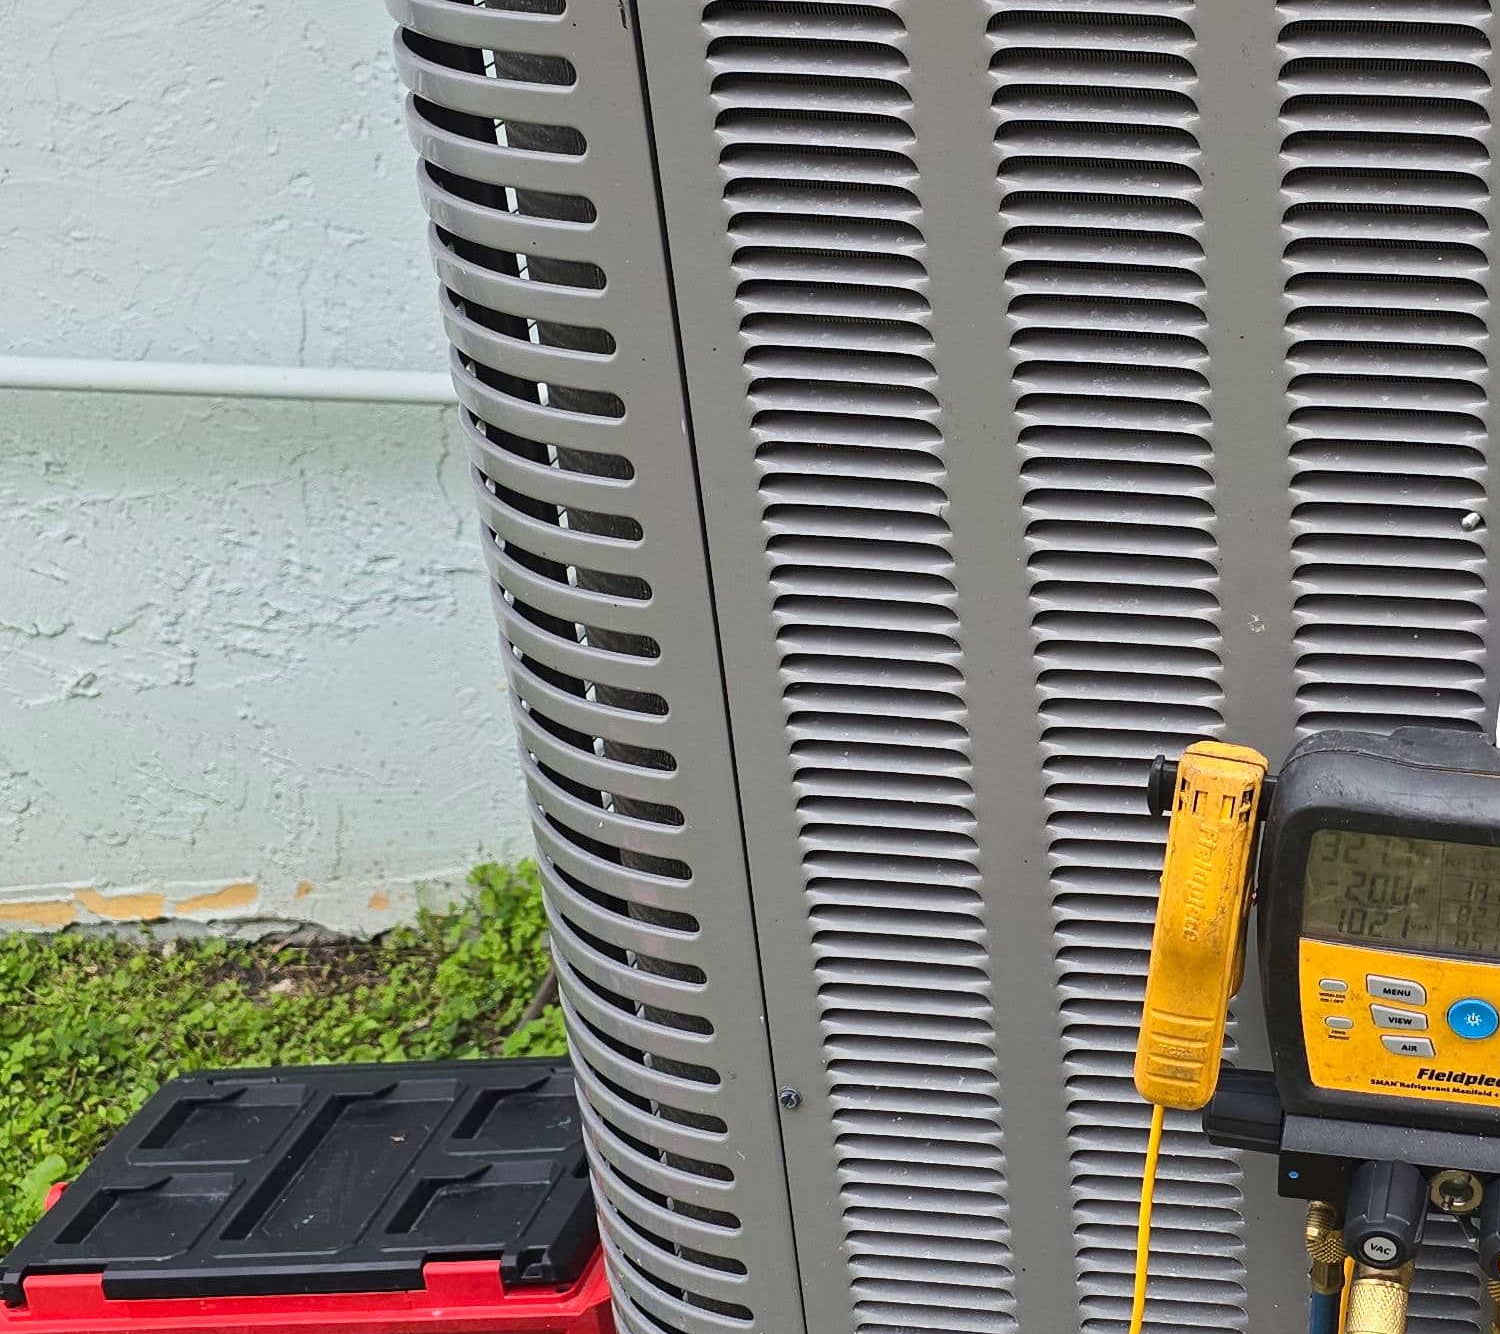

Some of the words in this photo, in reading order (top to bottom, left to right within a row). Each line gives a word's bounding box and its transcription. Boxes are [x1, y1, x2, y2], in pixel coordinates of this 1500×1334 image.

[1184, 825, 1220, 943] Fieldpiece
[1382, 987, 1411, 997] MENU
[1388, 1017, 1413, 1025] VIEW
[1400, 1044, 1418, 1053] AIR
[1400, 1082, 1450, 1093] Refrigerant
[1452, 1086, 1492, 1097] Manifold
[1370, 1241, 1393, 1257] VAC
